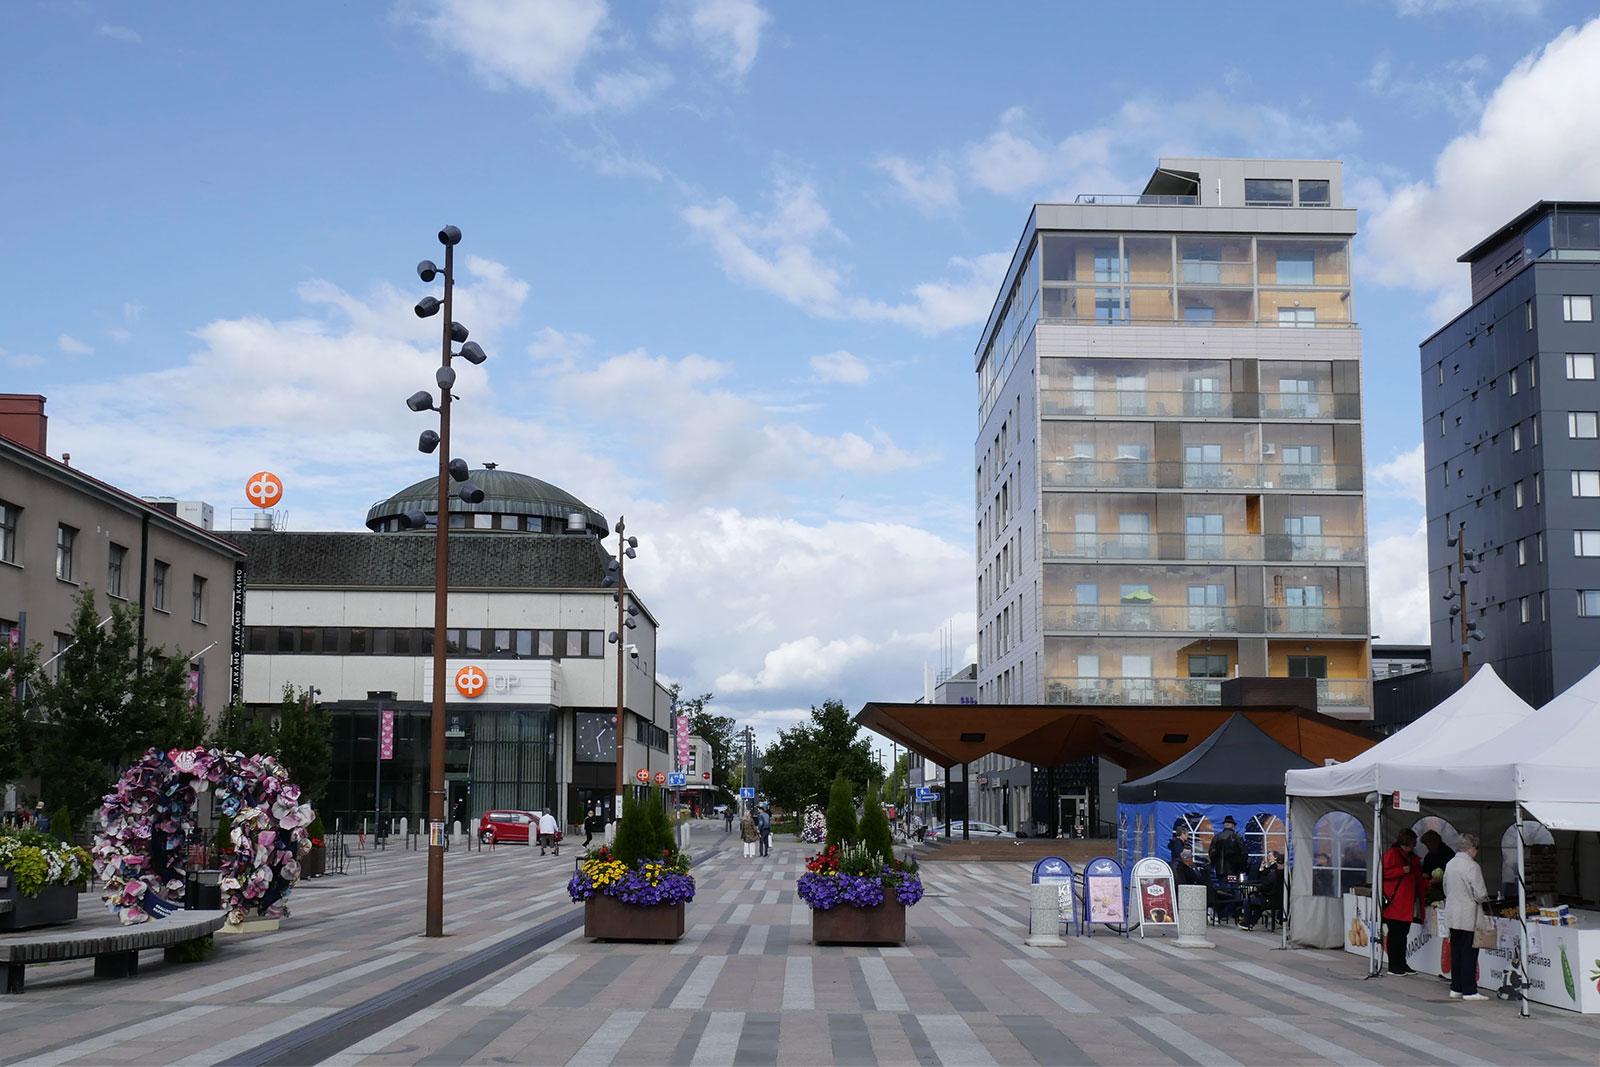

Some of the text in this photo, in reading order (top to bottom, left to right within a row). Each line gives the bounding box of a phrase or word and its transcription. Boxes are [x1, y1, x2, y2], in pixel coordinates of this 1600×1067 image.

[235, 569, 243, 605] JAKAMO
[234, 610, 242, 646] JAKAMO
[493, 674, 520, 692] OP
